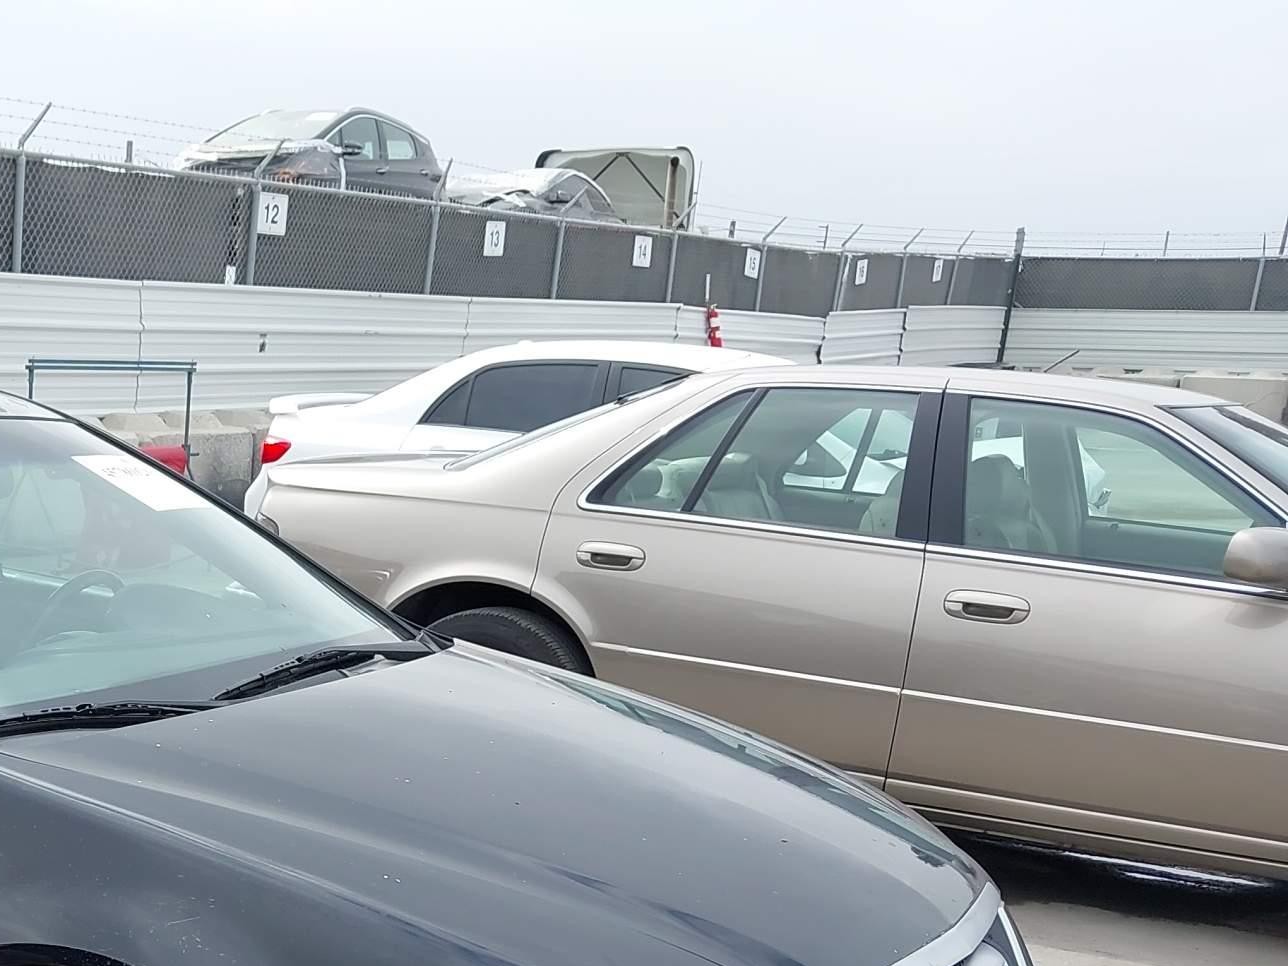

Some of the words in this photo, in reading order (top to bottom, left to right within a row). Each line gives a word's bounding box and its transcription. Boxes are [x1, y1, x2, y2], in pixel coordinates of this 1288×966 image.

[264, 203, 280, 225] 12
[490, 230, 500, 248] 13
[638, 243, 647, 260] 14
